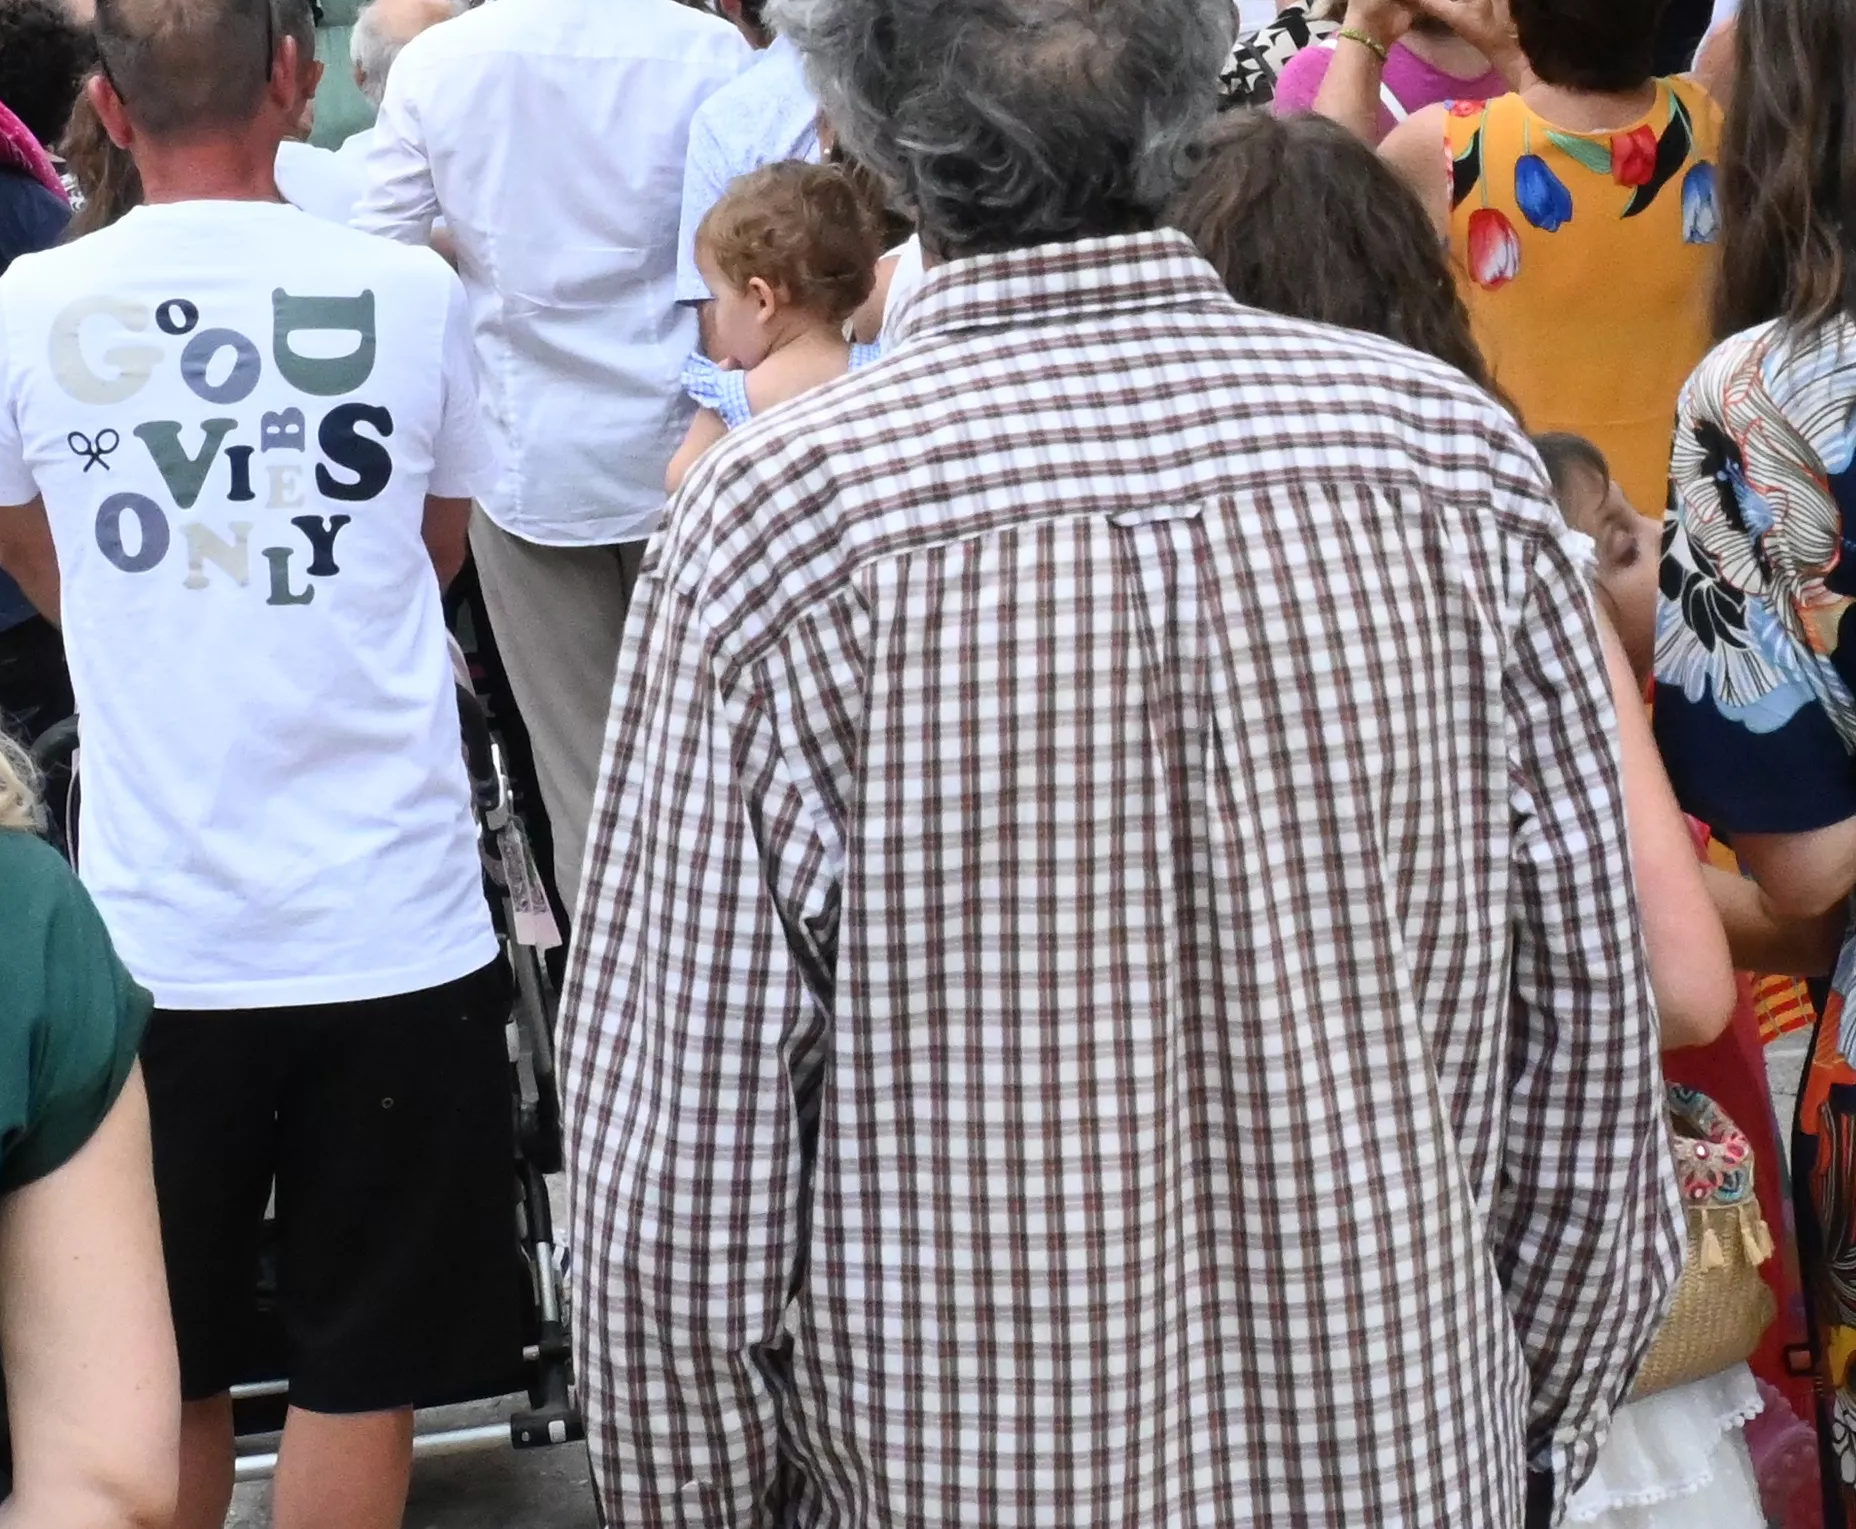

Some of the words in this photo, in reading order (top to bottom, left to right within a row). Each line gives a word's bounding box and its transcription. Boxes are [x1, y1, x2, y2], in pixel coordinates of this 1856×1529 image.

[48, 286, 376, 405] GOOD
[132, 401, 394, 510] VIBES
[94, 491, 352, 606] ONLY
